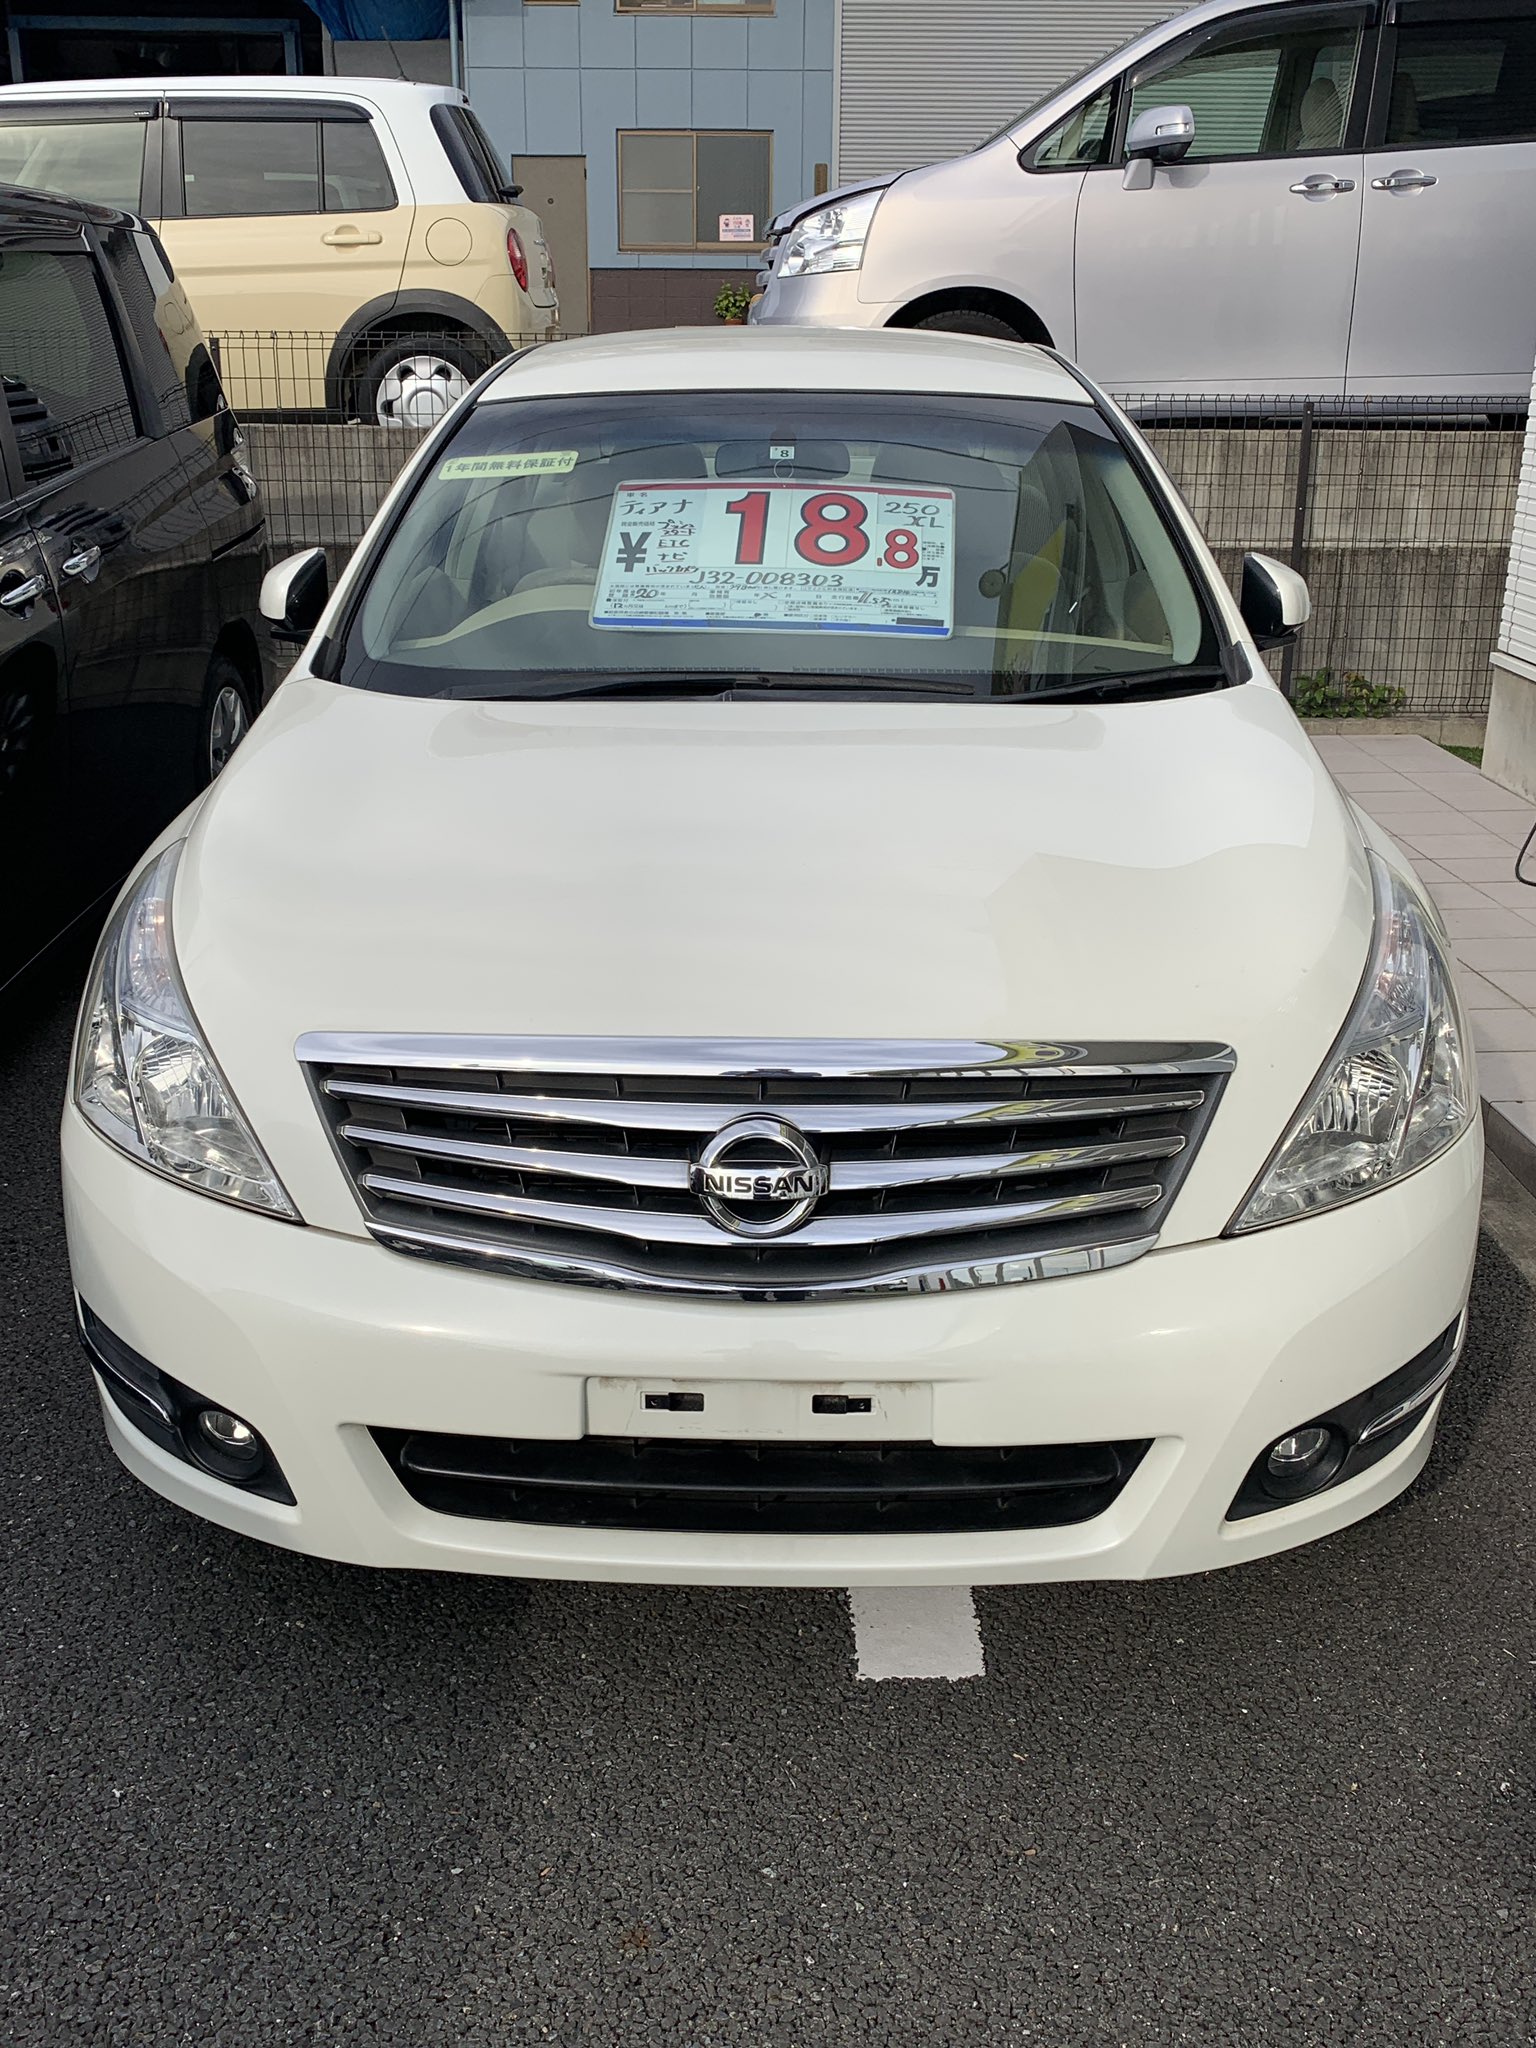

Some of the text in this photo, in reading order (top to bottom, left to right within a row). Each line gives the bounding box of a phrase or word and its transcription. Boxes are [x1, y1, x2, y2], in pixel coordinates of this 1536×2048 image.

[446, 457, 573, 472] 1年間無料保証付
[619, 499, 693, 516] ティアナ
[884, 502, 940, 515] 250
[903, 515, 945, 528] XL
[658, 539, 690, 548] ETC
[657, 552, 688, 561] ナビ
[689, 571, 844, 587] J32-008303
[915, 566, 941, 588] 万
[703, 1175, 813, 1193] NISSAN
